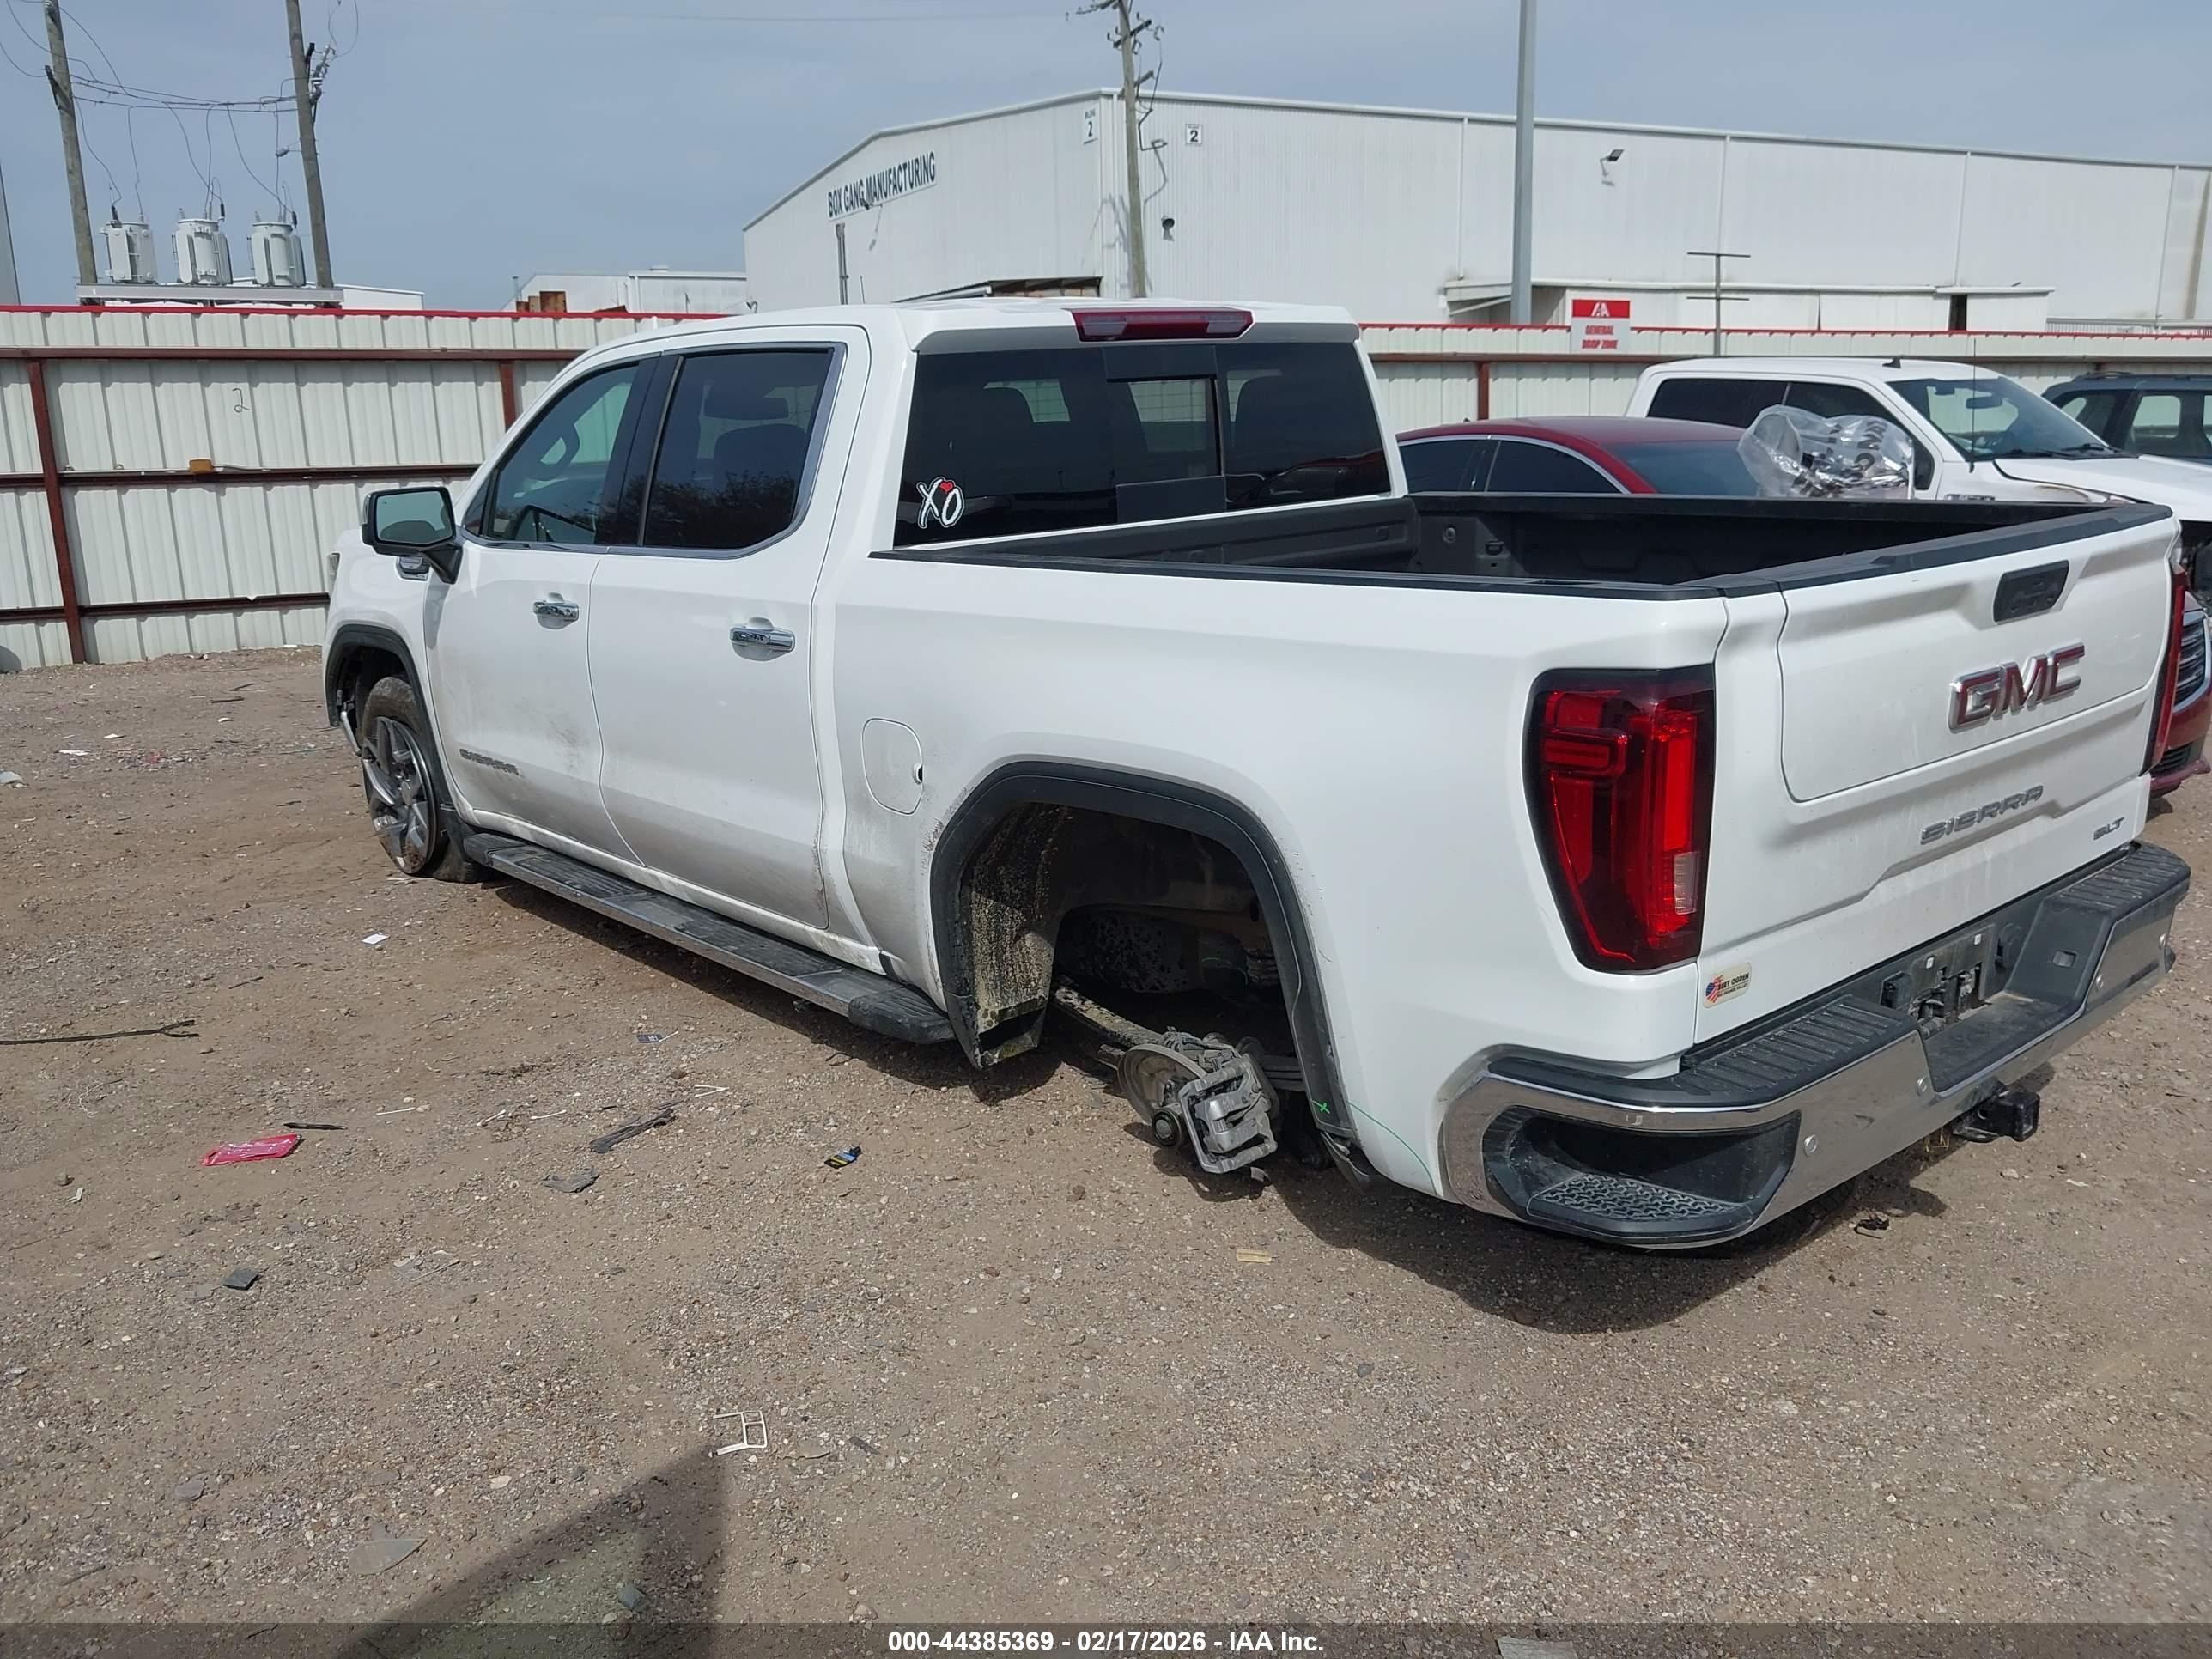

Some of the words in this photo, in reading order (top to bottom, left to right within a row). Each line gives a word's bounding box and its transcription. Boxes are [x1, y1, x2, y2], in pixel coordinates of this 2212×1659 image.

[1088, 121, 1093, 137] 2
[1189, 129, 1199, 143] 2
[828, 187, 843, 218] BOX
[843, 179, 865, 212] GANG
[866, 151, 935, 206] MANUFACTURING
[1582, 339, 1601, 349] DROP
[1601, 339, 1619, 349] ZONE
[916, 476, 965, 529] XO
[1948, 641, 2086, 735] GMC
[1920, 785, 2044, 846] SIERRA
[2094, 817, 2125, 841] SLT
[1731, 971, 1750, 986] OGDEN
